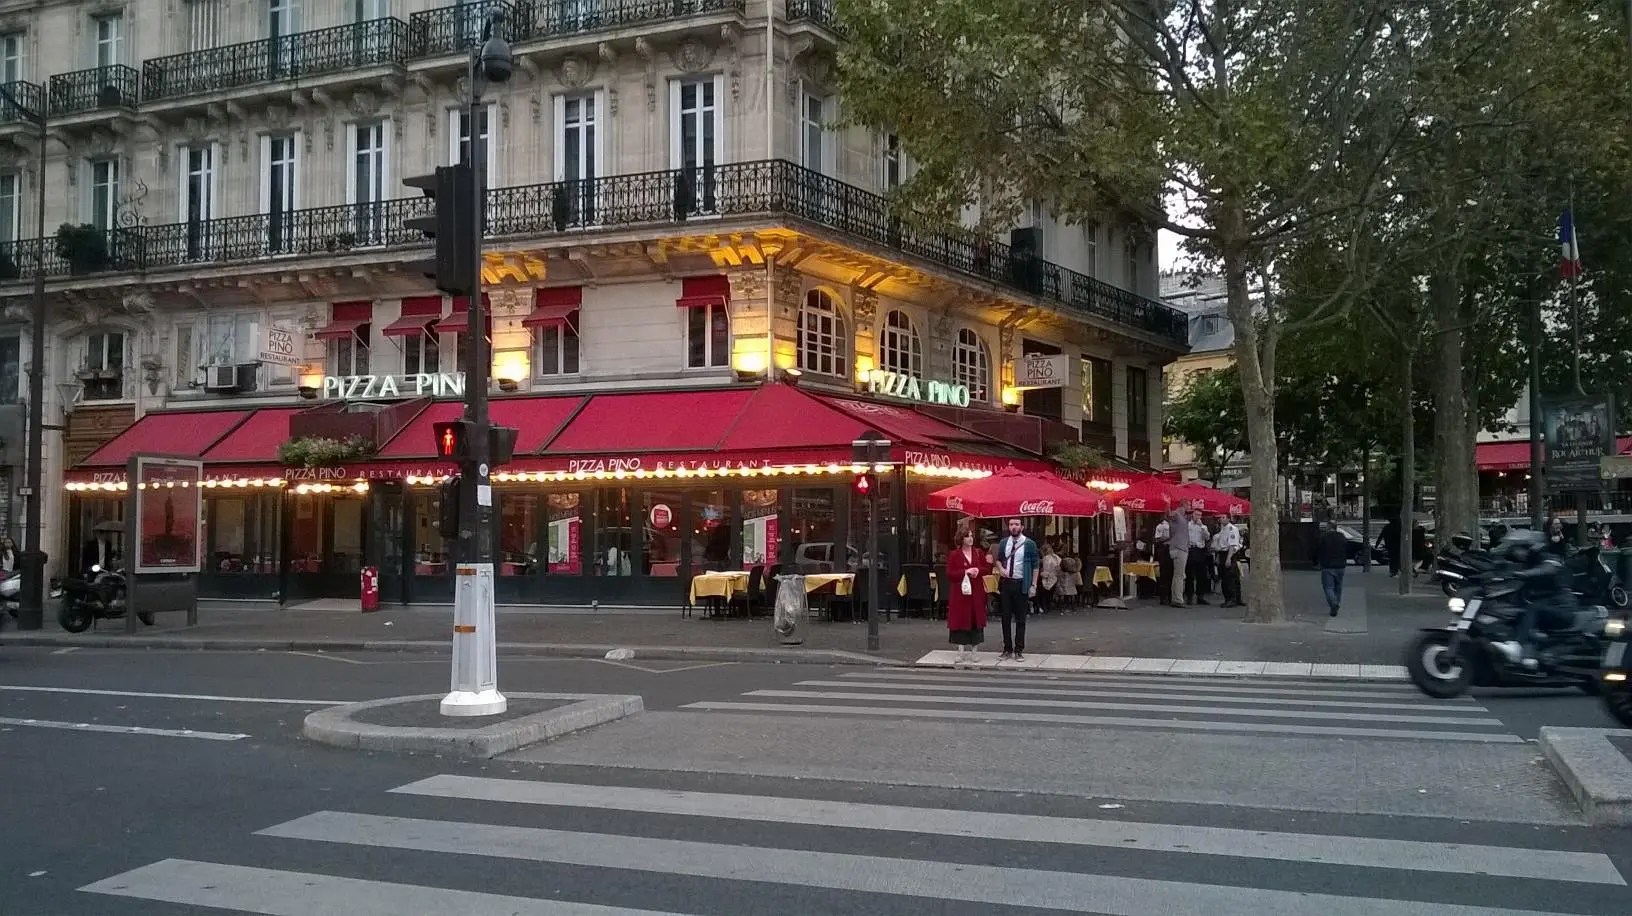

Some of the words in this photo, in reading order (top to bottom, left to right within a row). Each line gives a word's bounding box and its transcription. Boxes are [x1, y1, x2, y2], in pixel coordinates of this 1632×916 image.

[269, 331, 293, 344] PIZZA
[268, 341, 293, 353] PINO
[260, 352, 300, 363] RESTAURANT
[1027, 360, 1052, 369] PIZZA
[1027, 368, 1053, 377] PINO
[324, 375, 400, 399] PIZZA
[416, 373, 466, 396] PIN
[869, 370, 921, 401] PIZZA
[928, 381, 970, 408] PINO
[905, 448, 930, 465] PIZZA
[930, 454, 951, 468] PINO
[569, 459, 604, 473] PIZZA
[608, 457, 640, 471] PINO
[656, 459, 771, 470] RESTAURANT
[94, 472, 125, 483] PIZZA
[285, 467, 316, 479] PIZZA
[319, 467, 346, 478] PINO
[360, 468, 454, 478] RESTAURANT
